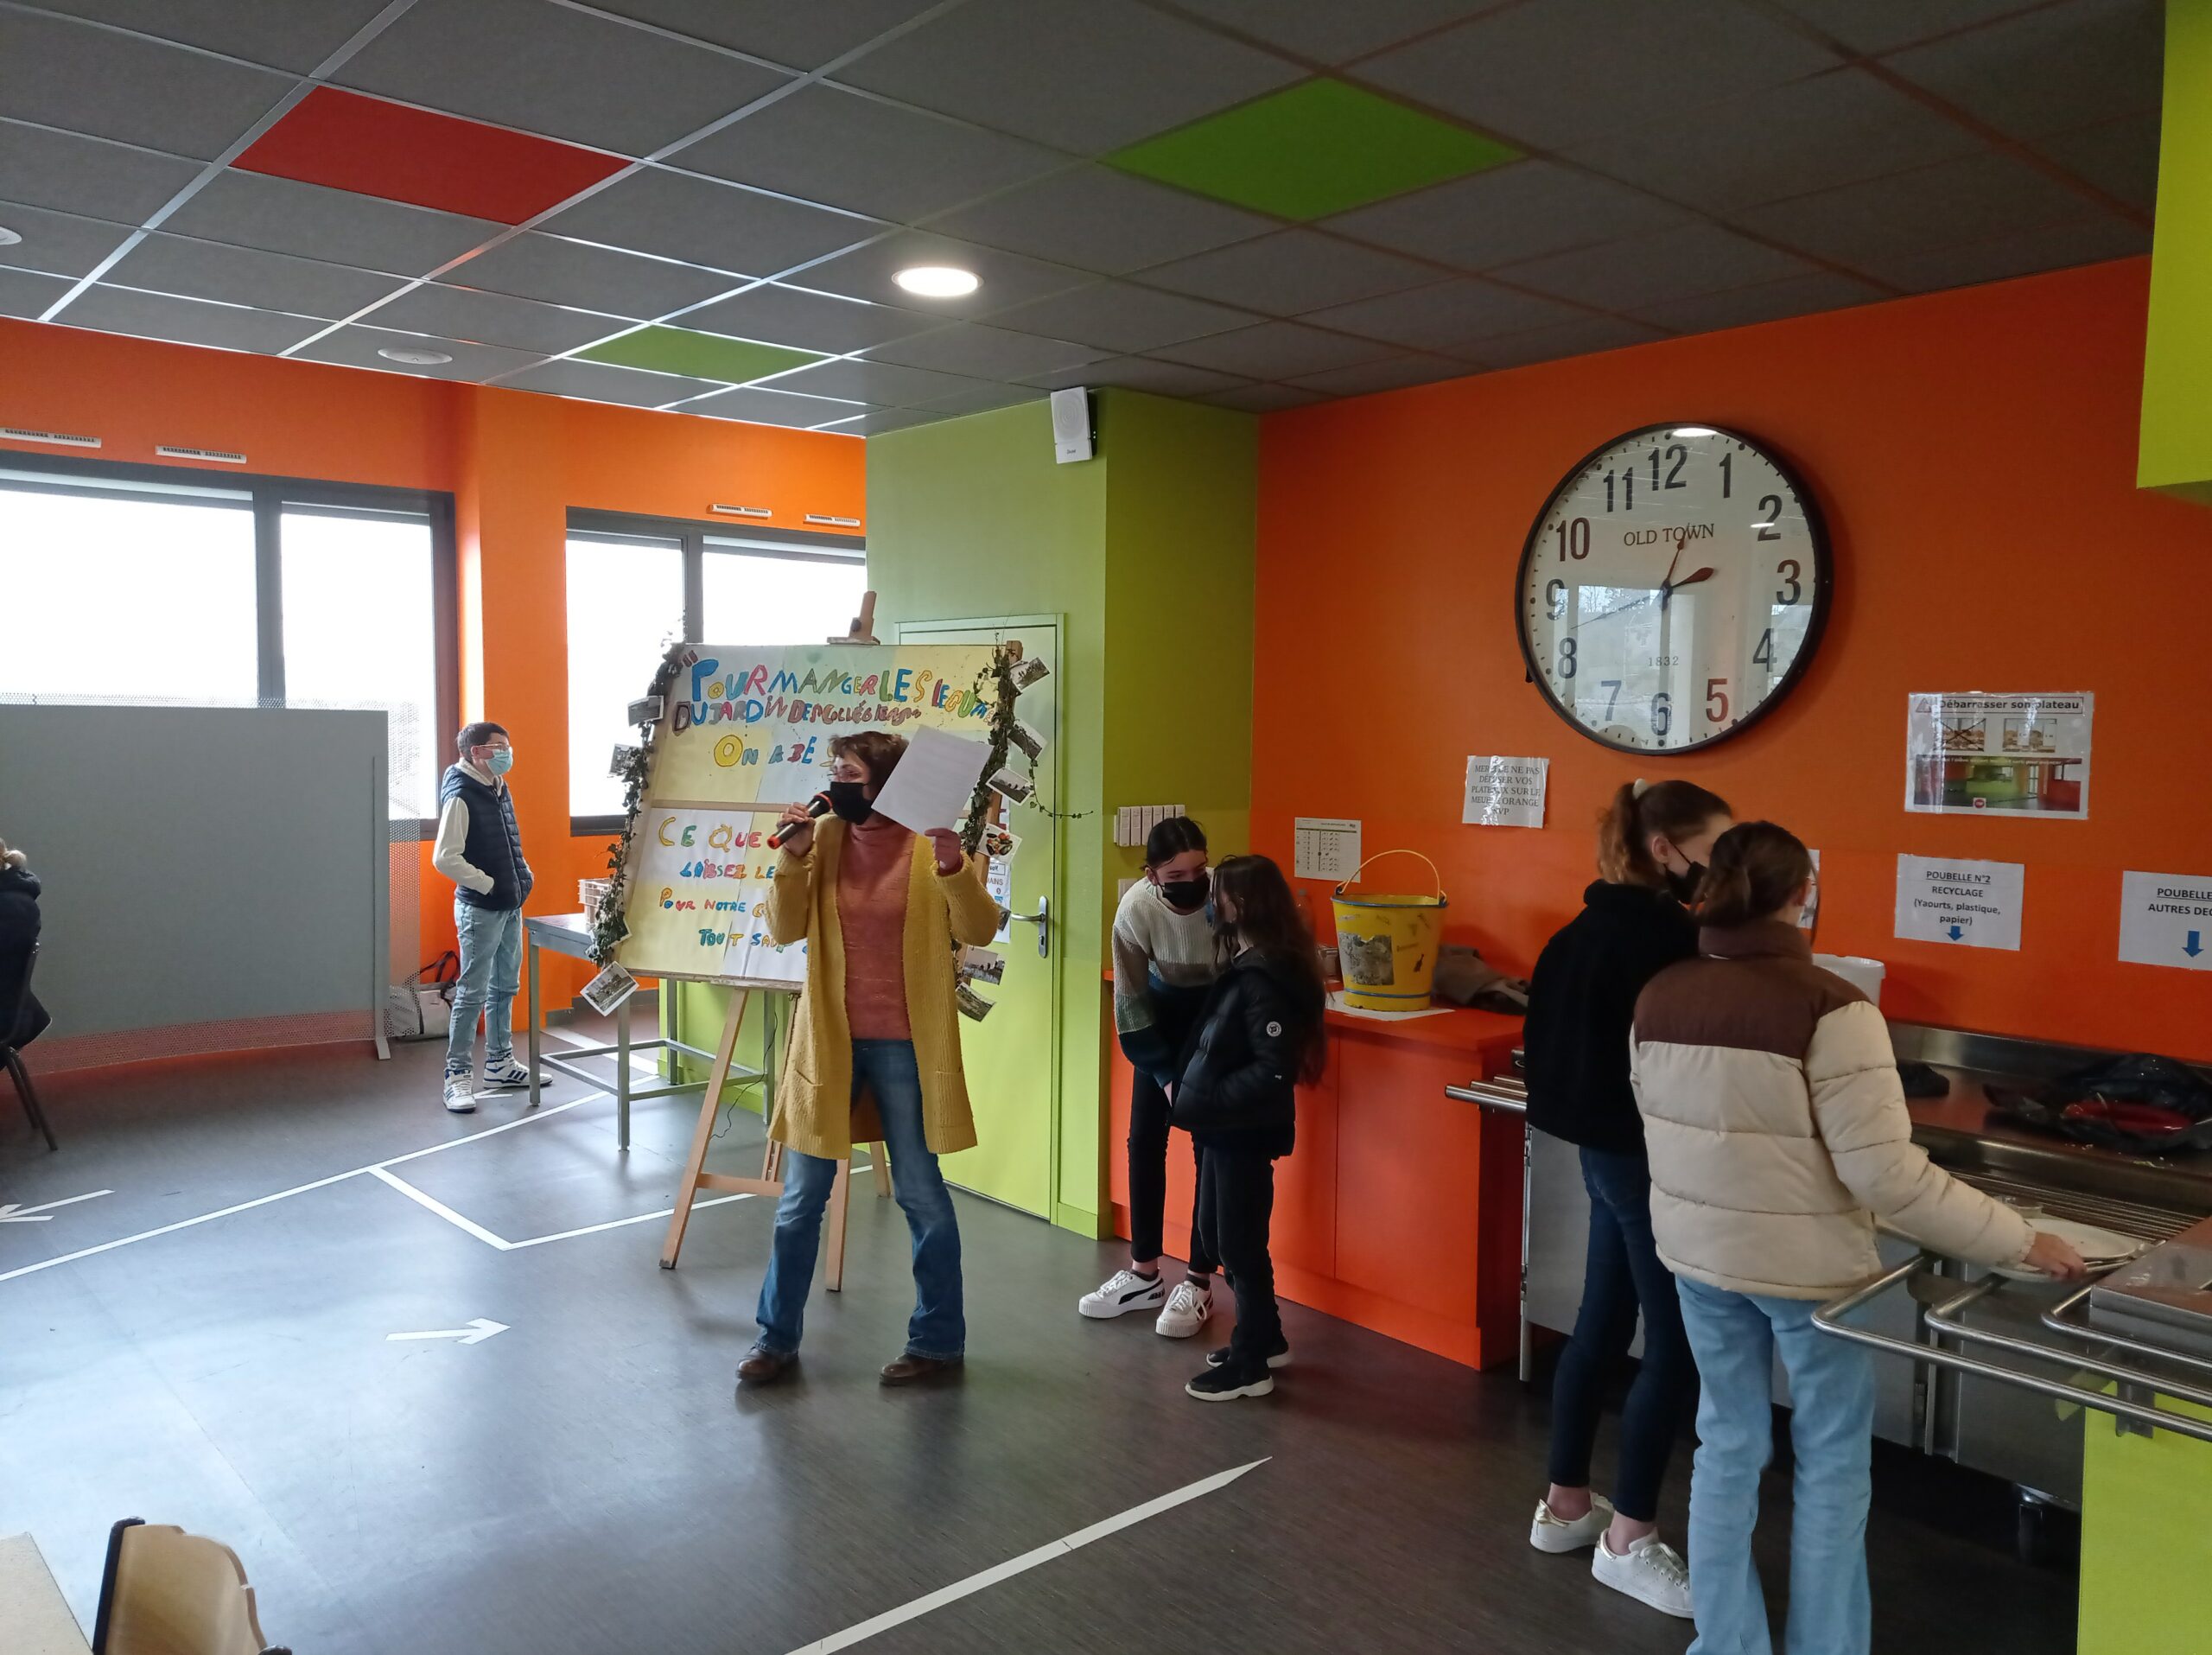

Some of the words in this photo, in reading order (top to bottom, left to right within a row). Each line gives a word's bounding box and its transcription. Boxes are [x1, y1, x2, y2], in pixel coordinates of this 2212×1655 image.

[1648, 443, 1688, 492] 12
[1719, 452, 1732, 499] 1
[1603, 467, 1634, 512] 11
[1624, 530, 1657, 546] OLD
[1662, 523, 1715, 544] TOWN
[1757, 494, 1783, 541] 2
[1556, 517, 1590, 562] 10
[1776, 559, 1801, 605] 3
[1545, 579, 1565, 621] 9
[1558, 637, 1578, 678] 8
[1648, 655, 1679, 667] 1832
[1752, 628, 1777, 672] 4
[767, 668, 878, 696] MANGER
[879, 668, 932, 703] LES
[1600, 680, 1622, 722] 7
[1706, 678, 1728, 722] 5
[672, 701, 708, 735] DU
[1650, 692, 1672, 736] 6
[2036, 698, 2080, 711] plateau
[1526, 767, 1541, 775] PAS
[1502, 797, 1539, 807] ORANGE
[709, 824, 762, 853] QUE
[1926, 871, 1972, 882] POUBELLE
[1974, 875, 1991, 884] N°2
[1932, 886, 1984, 898] RECYCLAGE
[704, 900, 747, 913] NOTRE
[1914, 898, 1954, 911] (Yaourts,
[1955, 902, 2001, 915] plastique,
[1939, 915, 1973, 926] papier)
[2148, 903, 2191, 914] AUTRES
